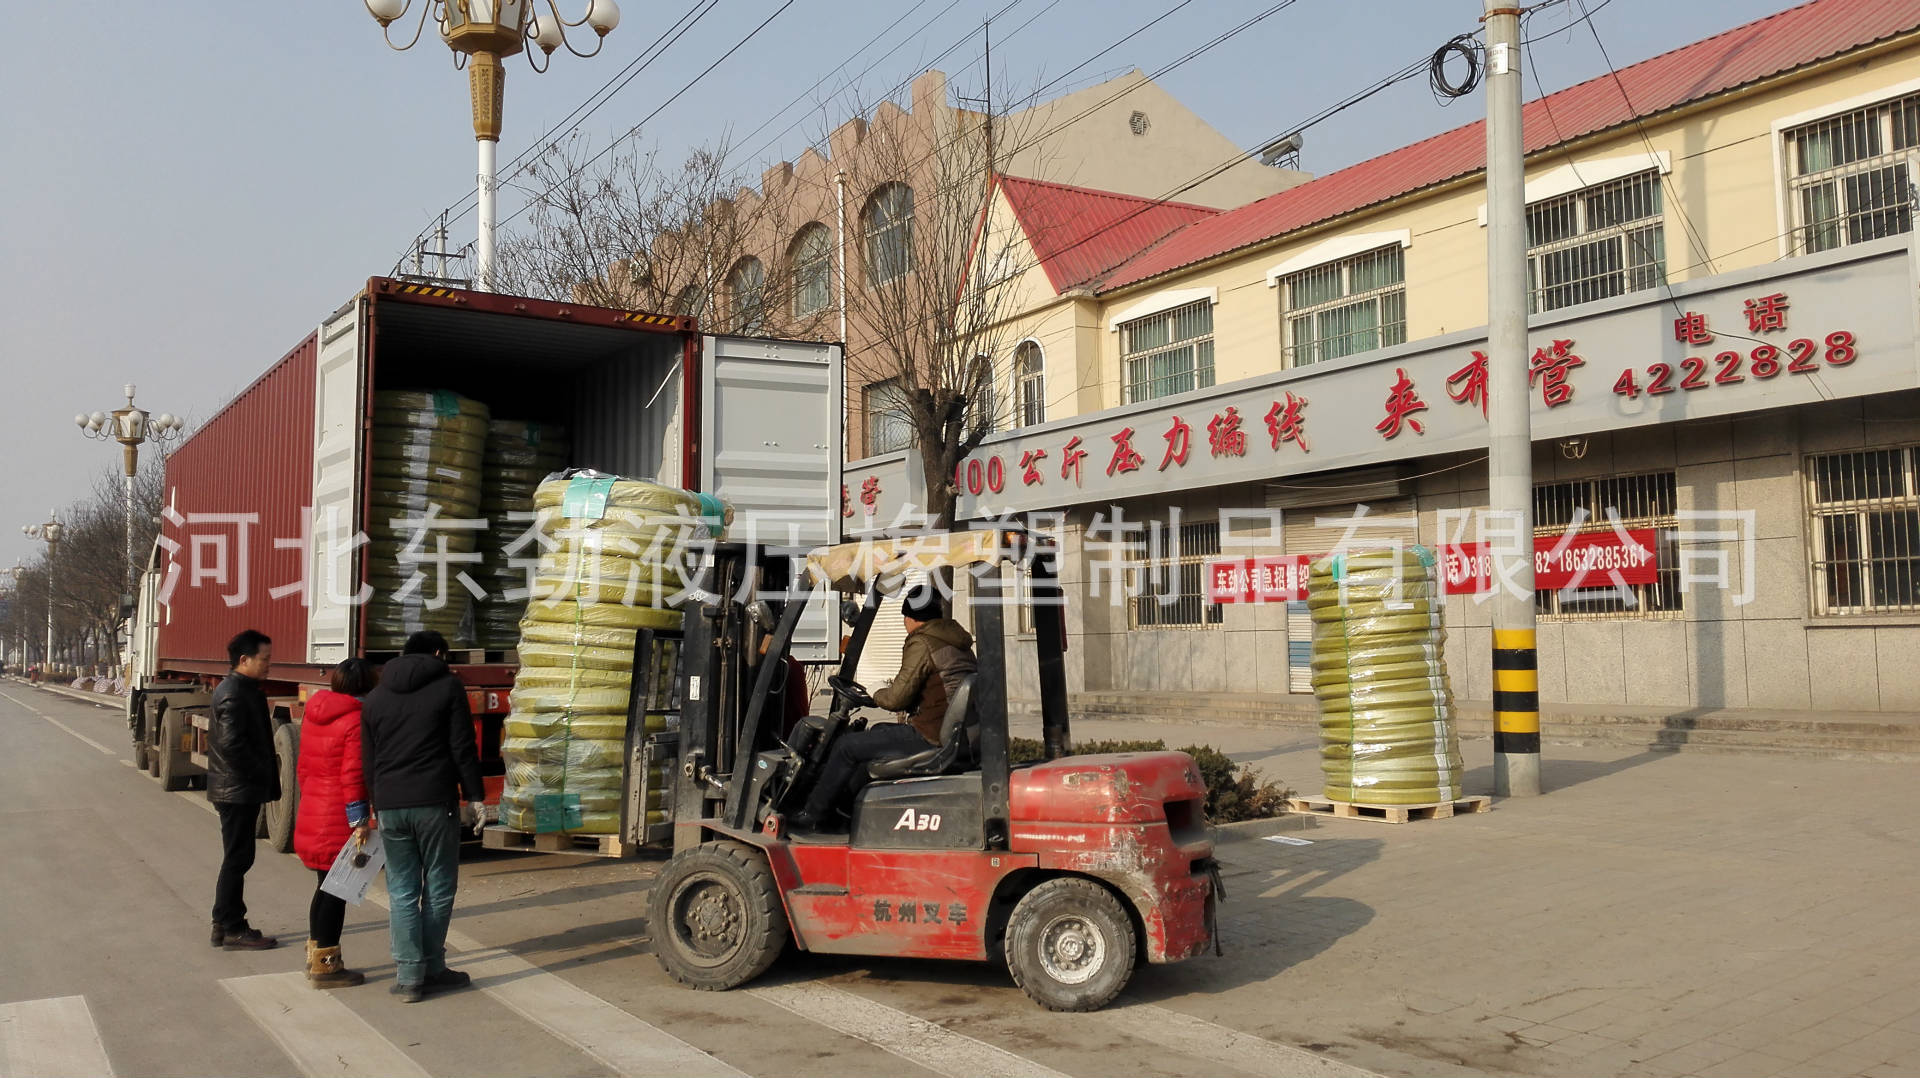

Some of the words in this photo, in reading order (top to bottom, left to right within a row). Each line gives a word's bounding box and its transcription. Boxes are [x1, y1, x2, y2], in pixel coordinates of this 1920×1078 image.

[1674, 292, 1791, 345] 电话
[1612, 330, 1857, 398] 4222828
[1559, 543, 1646, 571] 18632885361
[894, 808, 941, 831] A30
[873, 899, 968, 926] 杭州叉车
